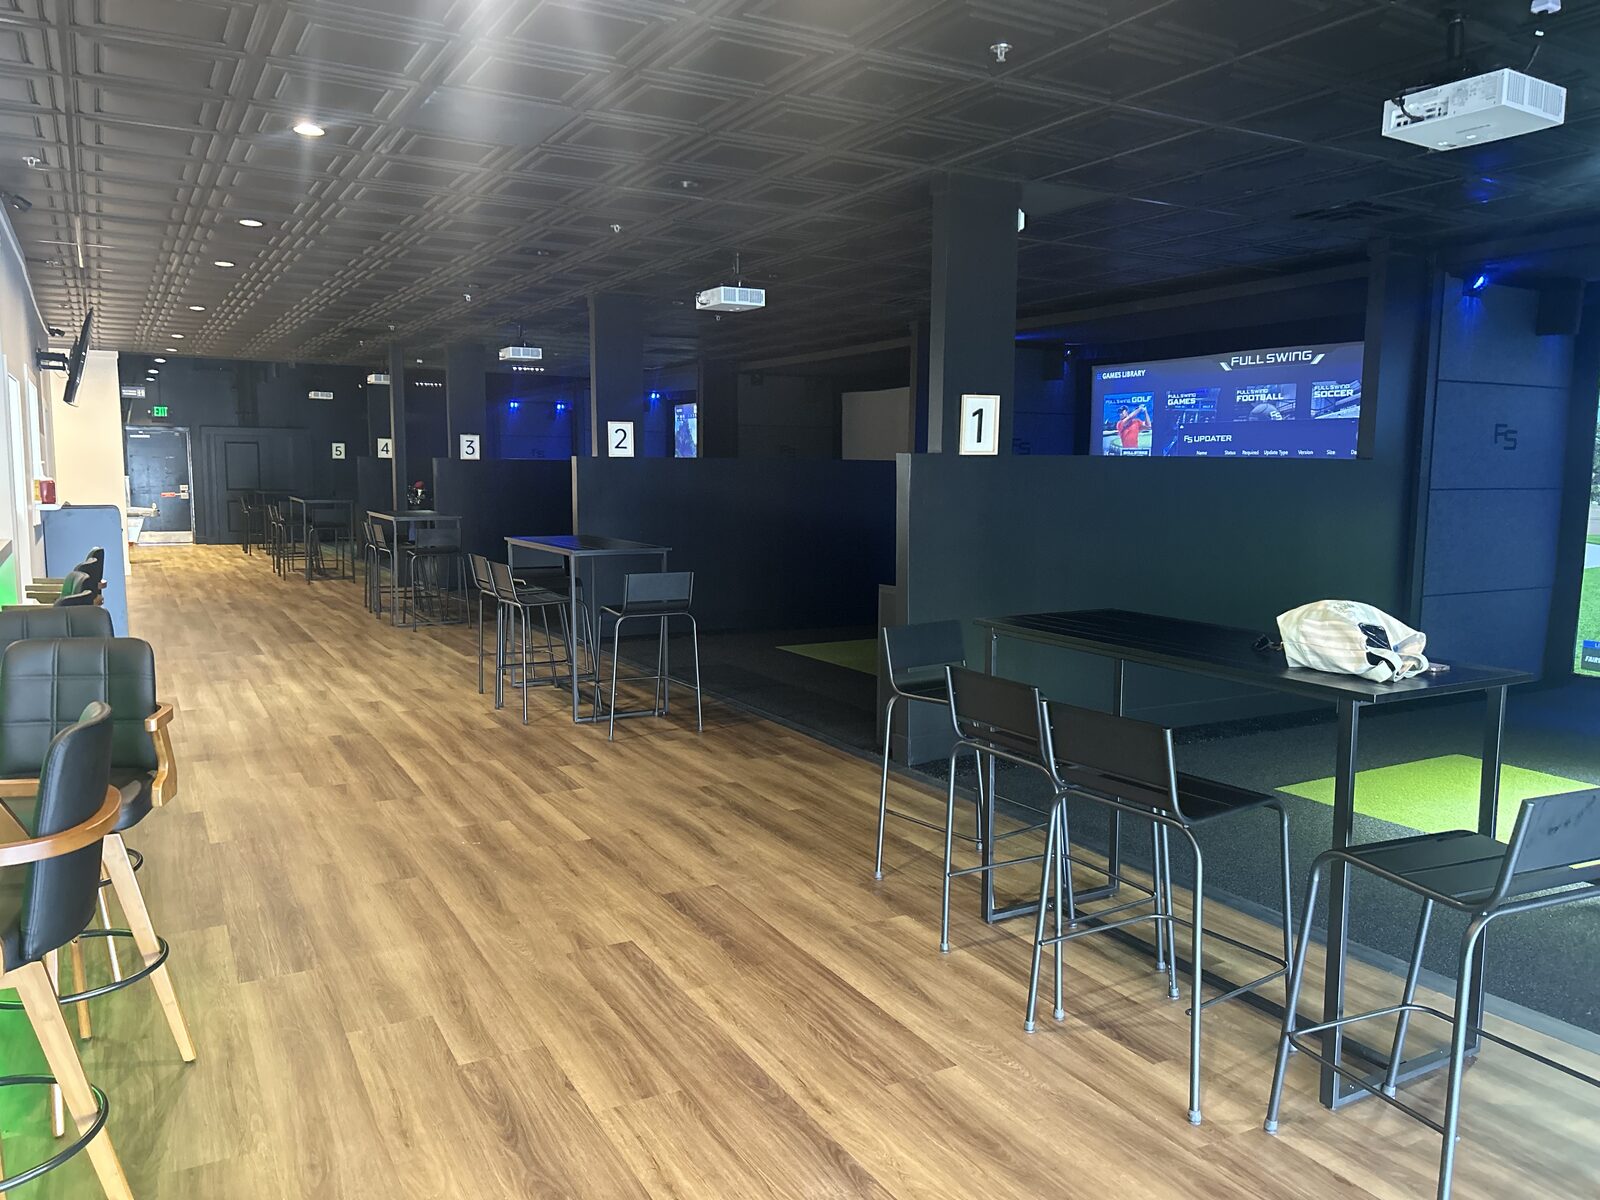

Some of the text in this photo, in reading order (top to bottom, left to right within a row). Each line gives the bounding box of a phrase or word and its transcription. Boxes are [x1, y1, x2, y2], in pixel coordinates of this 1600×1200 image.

[1231, 350, 1312, 366] FULL SWING
[1102, 370, 1146, 380] GAMES LIBRARY
[1236, 393, 1284, 402] FOOTBALL
[1313, 389, 1354, 398] SOCCER
[1167, 398, 1196, 406] GAMES
[154, 406, 168, 417] EXIT
[972, 408, 984, 443] 1
[614, 428, 628, 449] 2
[1194, 434, 1232, 442] UPDATER
[1494, 423, 1518, 451] FS
[335, 446, 342, 456] 5
[381, 442, 390, 455] 4
[465, 440, 476, 456] 3
